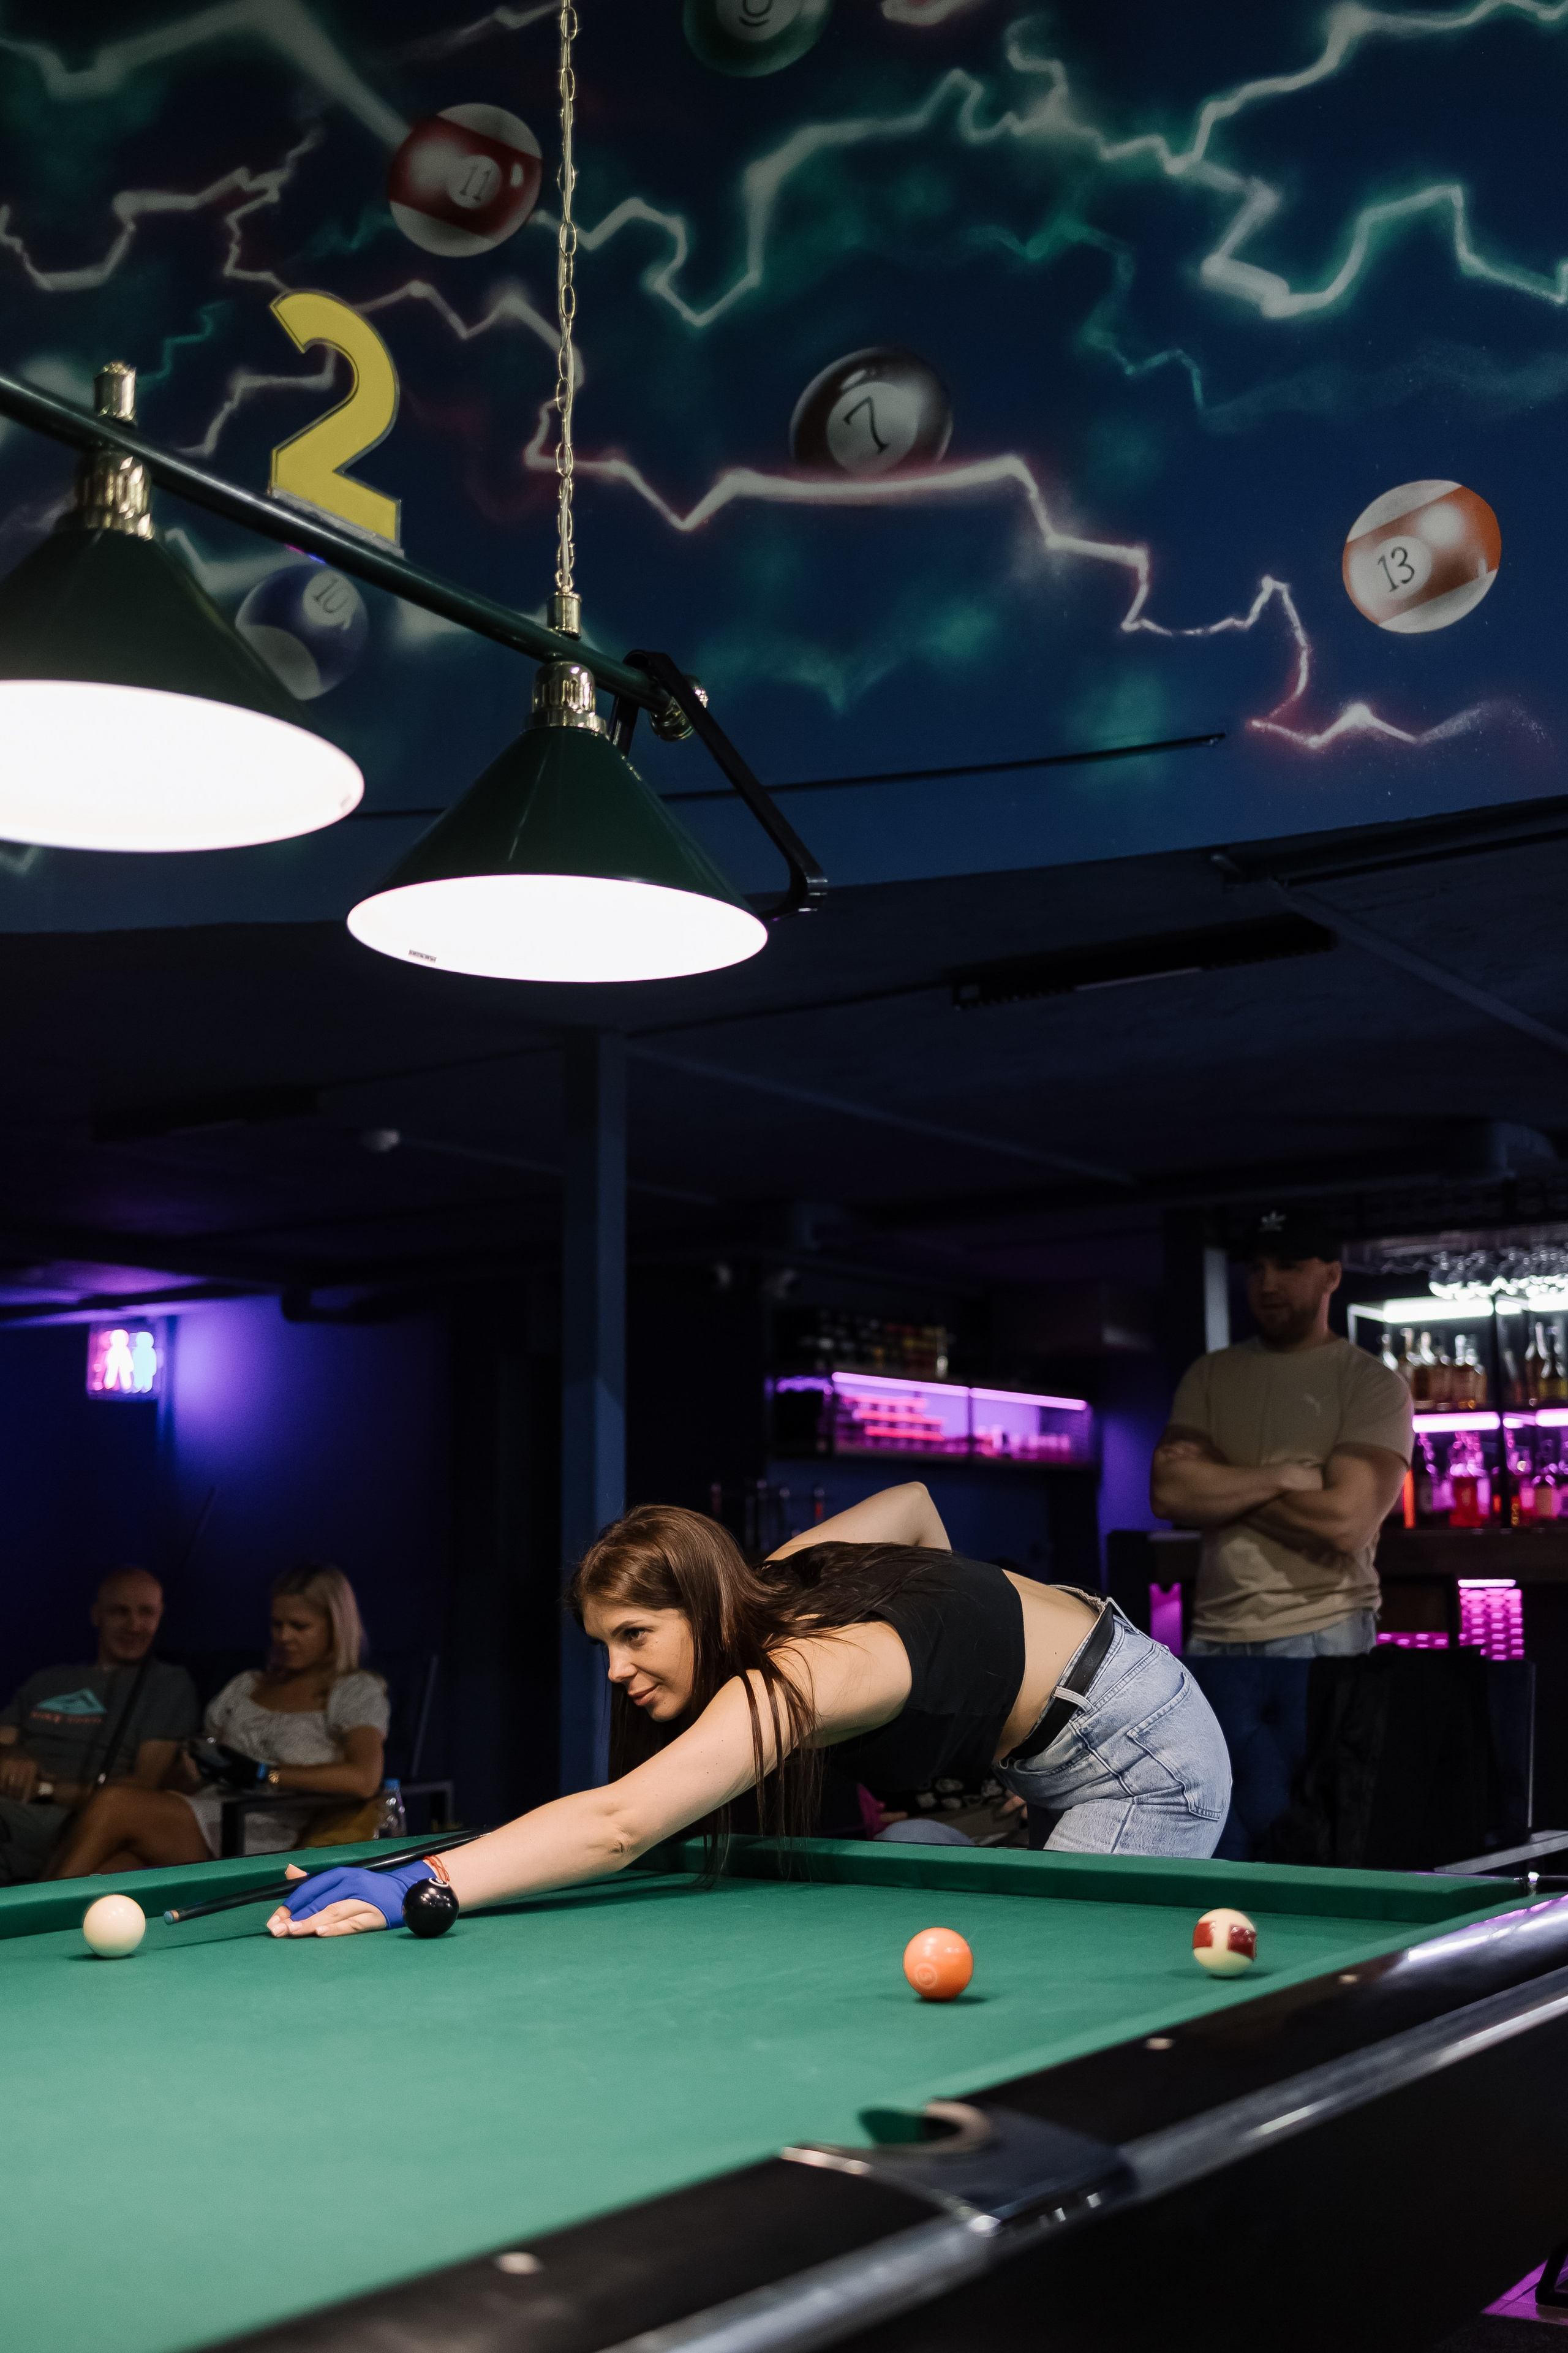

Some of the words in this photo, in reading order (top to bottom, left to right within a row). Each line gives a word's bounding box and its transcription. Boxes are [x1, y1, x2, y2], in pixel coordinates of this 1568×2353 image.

[270, 288, 402, 545] 2
[843, 395, 890, 453] 7
[1378, 546, 1414, 592] 13
